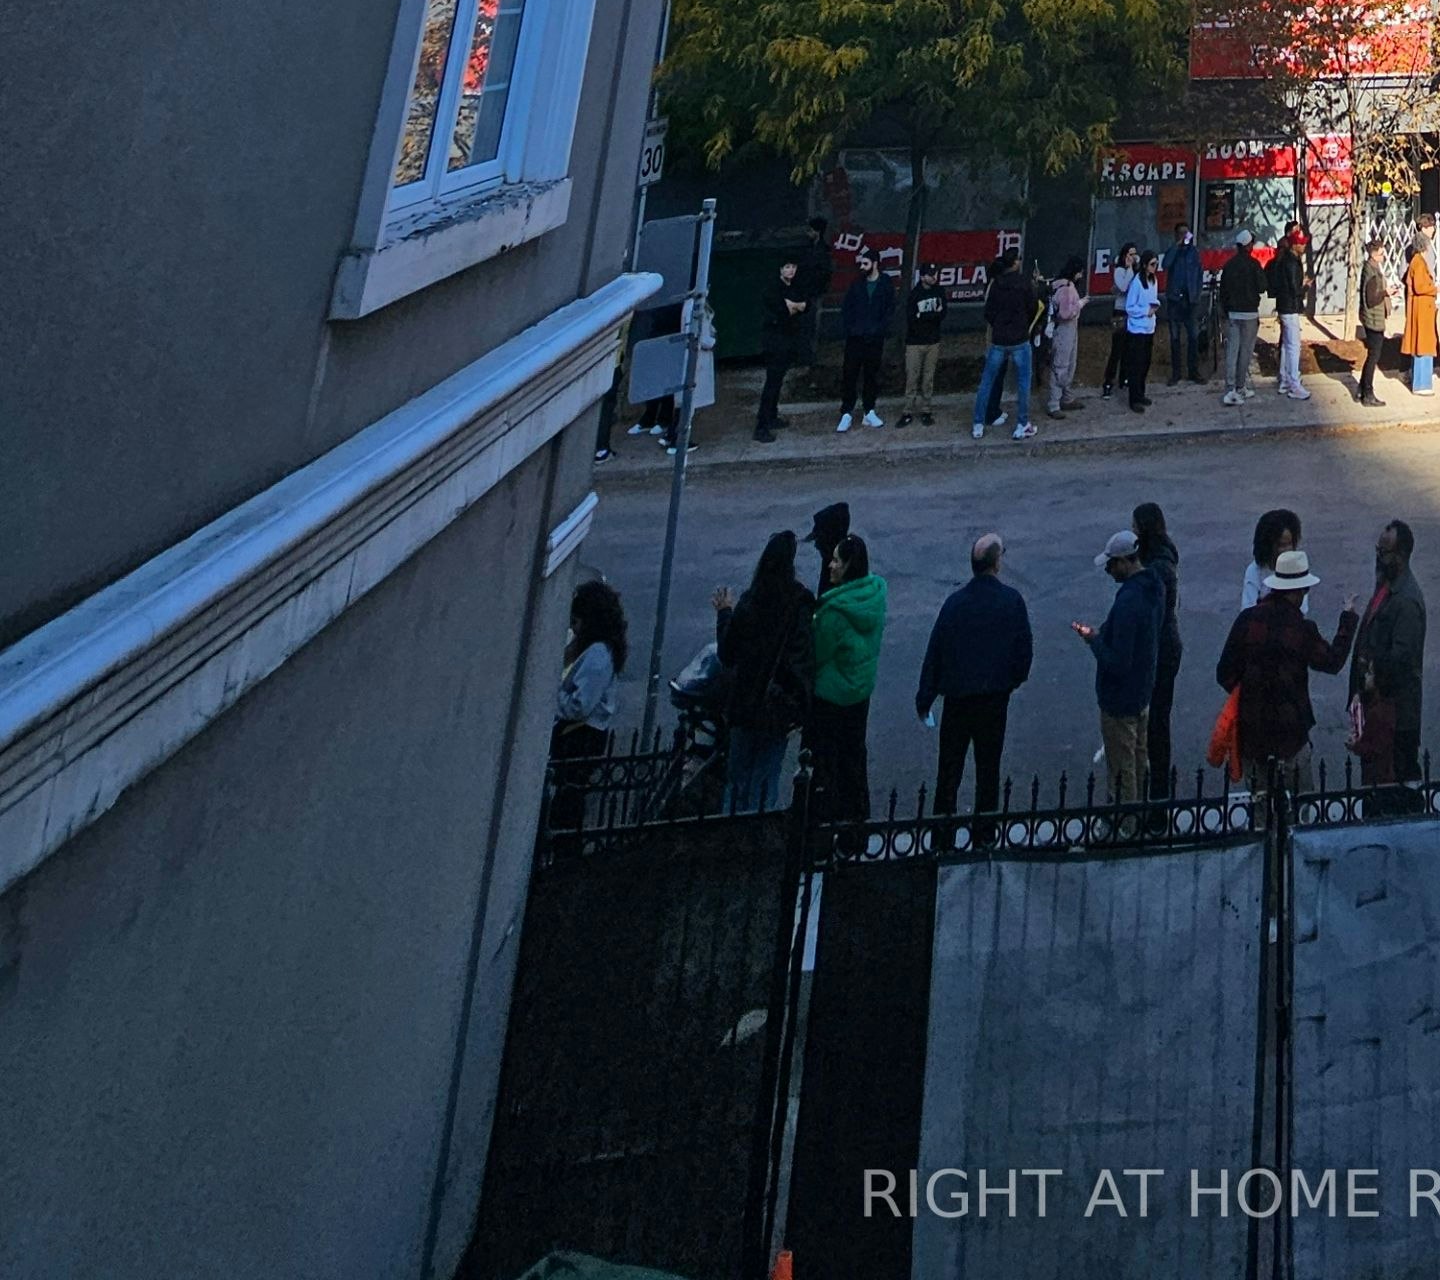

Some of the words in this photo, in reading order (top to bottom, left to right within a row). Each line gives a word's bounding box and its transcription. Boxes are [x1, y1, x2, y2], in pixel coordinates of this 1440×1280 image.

[641, 144, 662, 177] 30
[1101, 157, 1186, 182] ESCAPE
[939, 265, 988, 286] BLA
[951, 289, 984, 299] ESCAP
